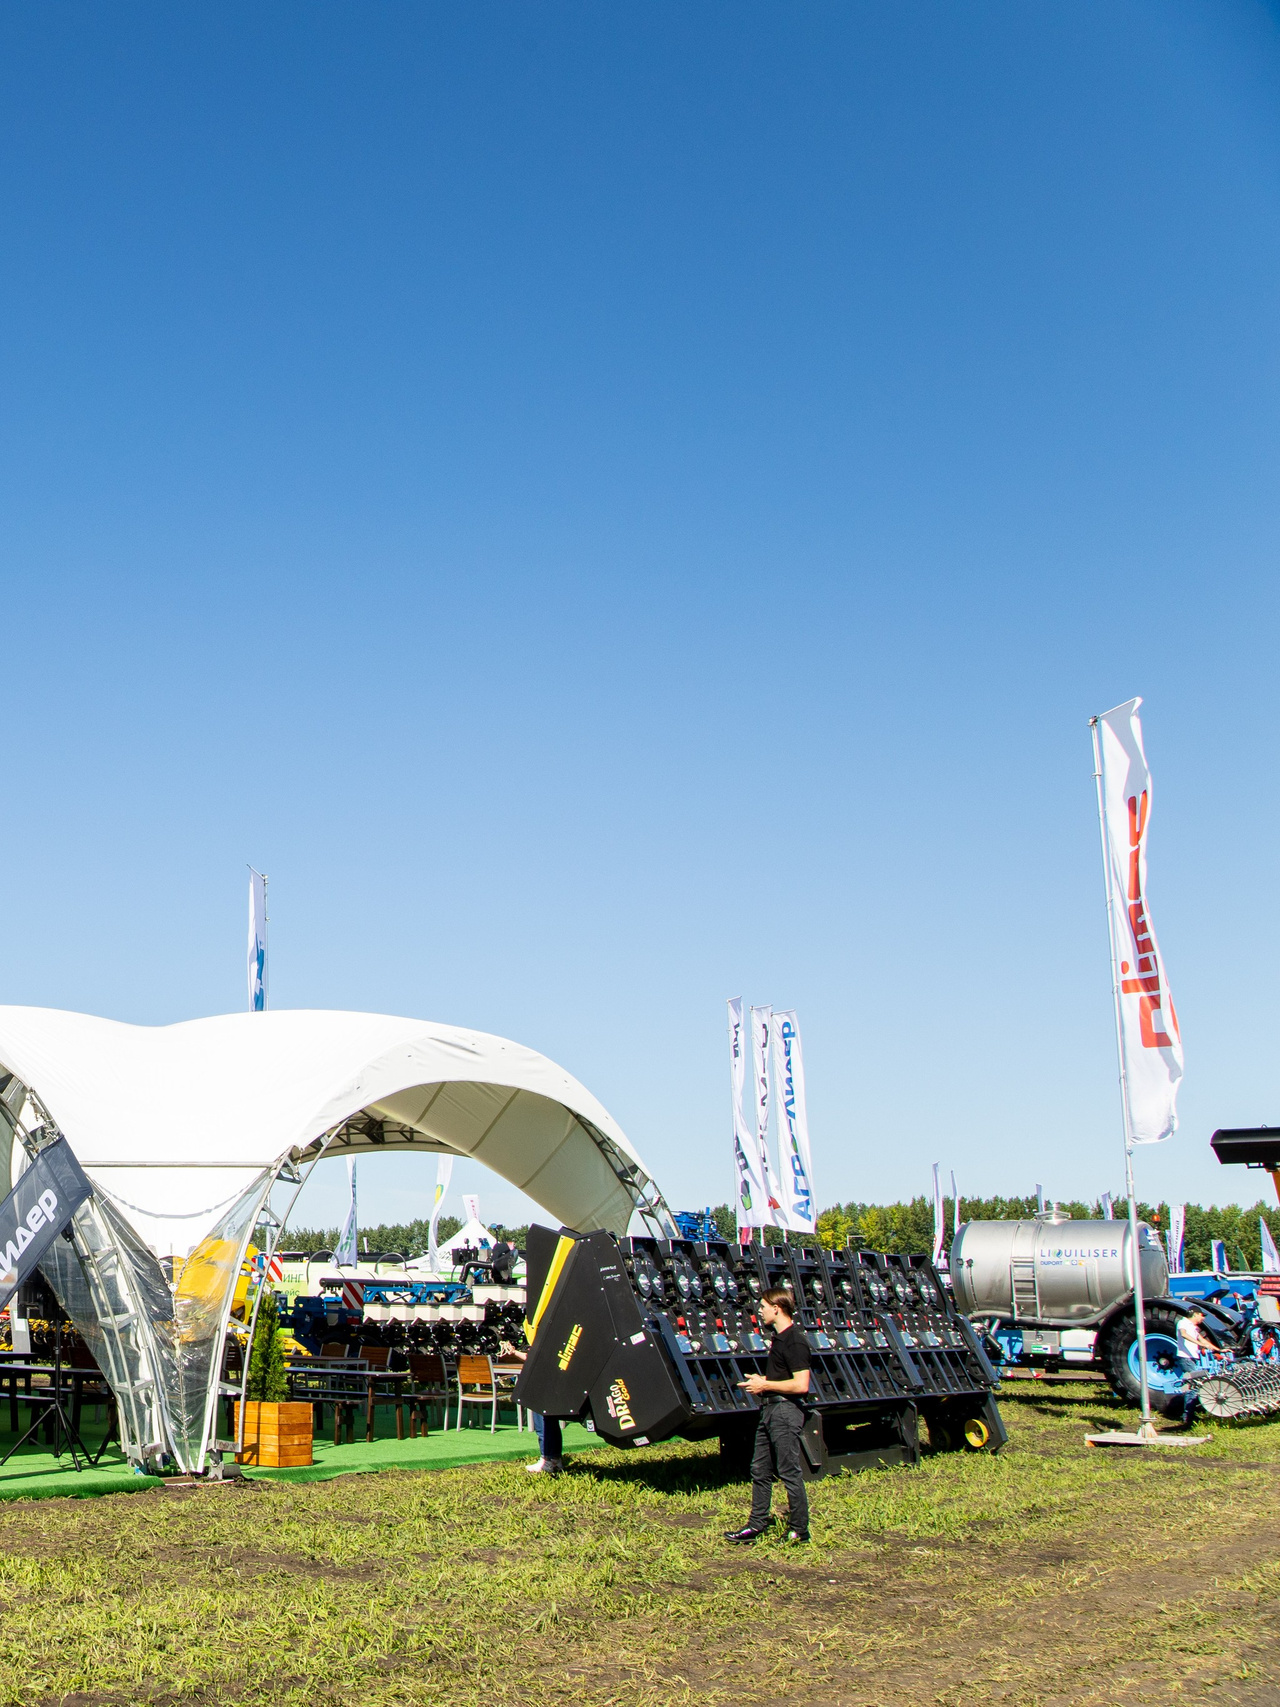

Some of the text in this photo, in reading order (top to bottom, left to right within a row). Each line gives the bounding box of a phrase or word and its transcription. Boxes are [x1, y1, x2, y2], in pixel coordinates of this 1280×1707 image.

[1040, 1248, 1118, 1259] LIQUILISER
[614, 1378, 631, 1401] Gold
[610, 1384, 636, 1430] DRAGO
